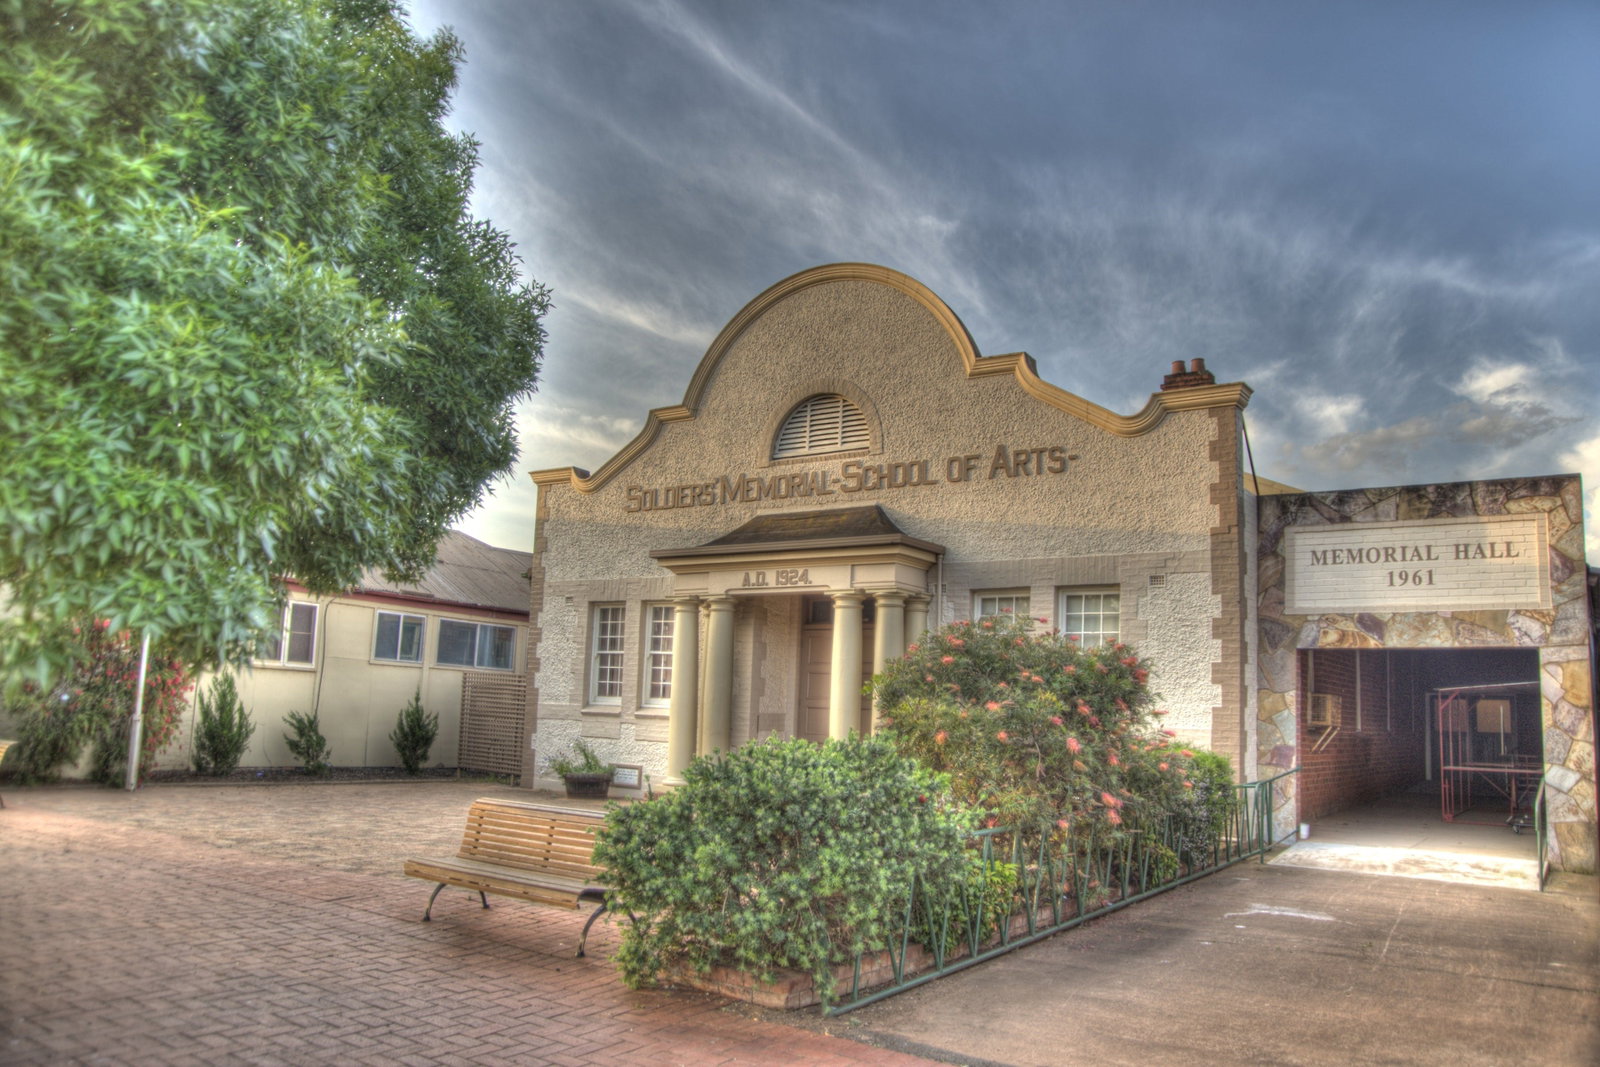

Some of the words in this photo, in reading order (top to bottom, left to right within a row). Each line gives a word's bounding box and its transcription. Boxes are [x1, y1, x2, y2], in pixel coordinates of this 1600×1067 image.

[946, 454, 981, 483] OF
[1310, 545, 1439, 566] MEMORIAL
[1453, 541, 1520, 560] HALL
[1387, 569, 1435, 587] 1961
